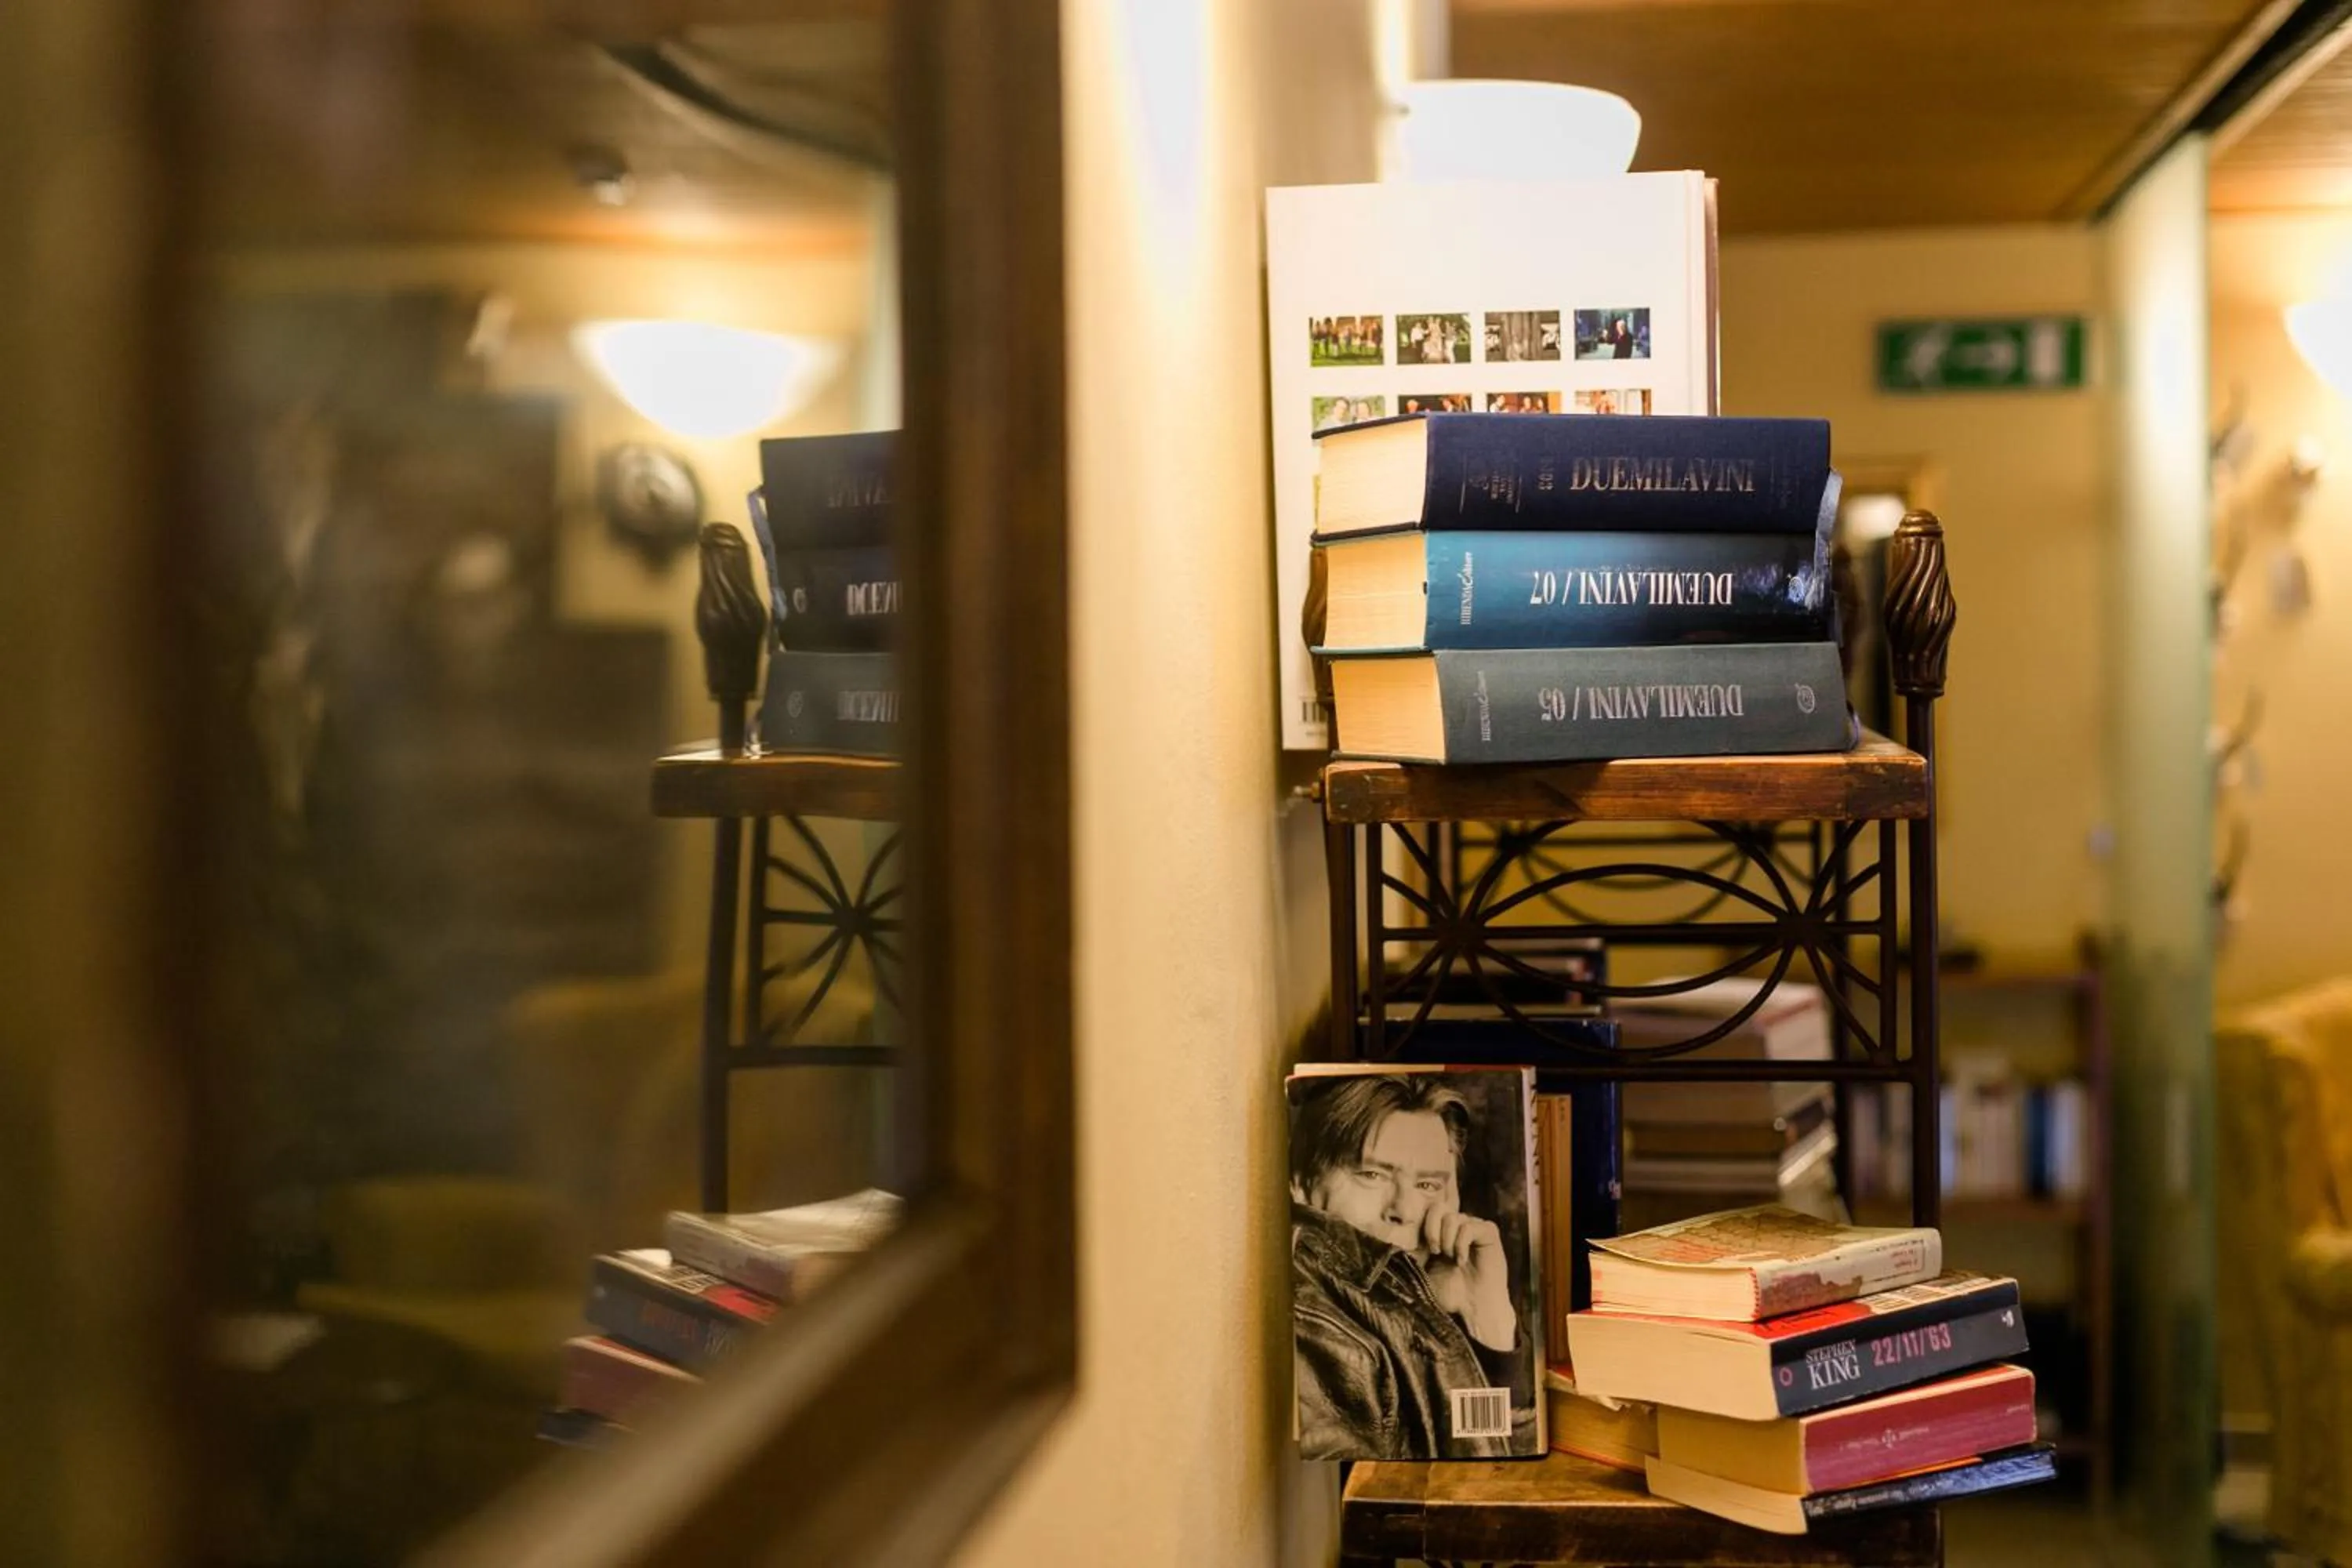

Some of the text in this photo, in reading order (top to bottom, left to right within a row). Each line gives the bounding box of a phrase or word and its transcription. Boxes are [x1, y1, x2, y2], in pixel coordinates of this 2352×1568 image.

[1570, 458, 1755, 492] DUEMILAVINI
[1530, 572, 1555, 604] 07
[1579, 571, 1733, 606] DUEMILAVINI
[1539, 687, 1566, 721] 05
[1588, 684, 1744, 720] DUEMILAVINI
[1805, 1340, 1857, 1365] STEPHEN
[1808, 1355, 1860, 1390] KING
